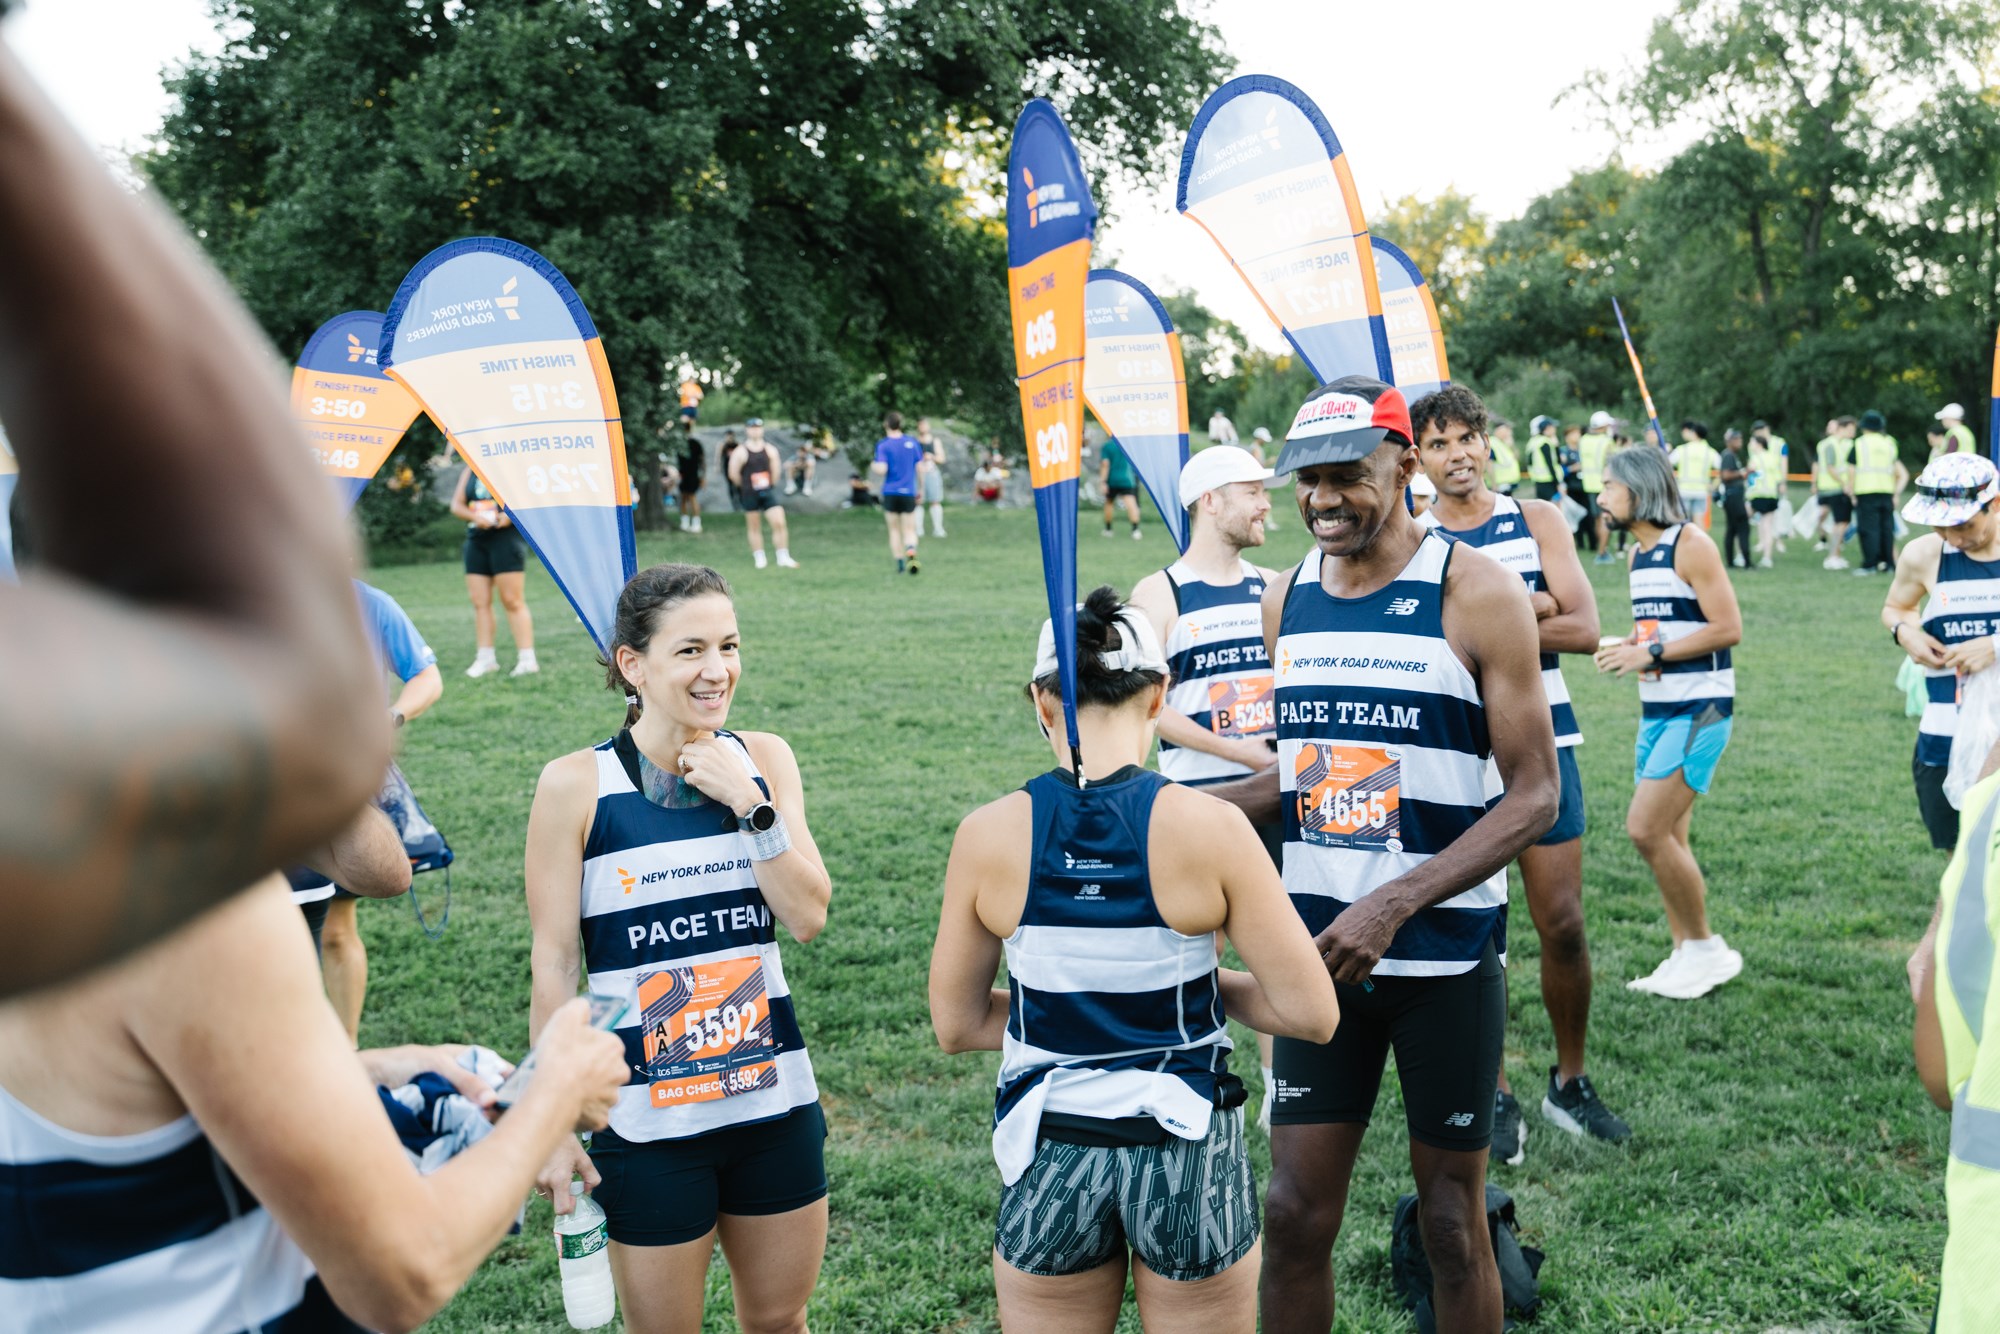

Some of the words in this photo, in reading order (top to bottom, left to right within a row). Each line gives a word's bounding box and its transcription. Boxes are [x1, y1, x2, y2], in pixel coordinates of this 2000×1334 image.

[1026, 309, 1056, 359] 4:05
[314, 380, 350, 391] FINISH
[353, 384, 378, 394] TIME
[310, 396, 366, 419] 3:50
[1319, 400, 1357, 416] COACH
[338, 433, 356, 442] PER
[360, 435, 384, 445] MILE
[1036, 421, 1069, 469] 9:20
[1500, 553, 1533, 562] RUNNERS
[1203, 623, 1219, 632] NEW
[1220, 620, 1239, 630] YORK
[1240, 618, 1259, 628] ROAD
[1193, 648, 1241, 670] PACE
[1293, 657, 1312, 669] NEW
[1312, 657, 1340, 668] YORK
[1340, 657, 1370, 669] ROAD
[1371, 658, 1429, 673] RUNNERS
[1219, 710, 1231, 729] B
[1235, 700, 1275, 729] 5293
[1280, 701, 1329, 725] PACE
[1336, 701, 1421, 731] TEAM
[1319, 787, 1387, 829] 4655
[641, 870, 669, 885] NEW
[670, 865, 702, 879] YORK
[704, 860, 734, 874] ROAD
[627, 913, 708, 949] PACE
[656, 1021, 667, 1037] A
[684, 1002, 760, 1052] 5592
[657, 1039, 669, 1055] A
[658, 1086, 683, 1100] BAG
[686, 1080, 727, 1096] CHECK
[729, 1068, 760, 1092] 5592
